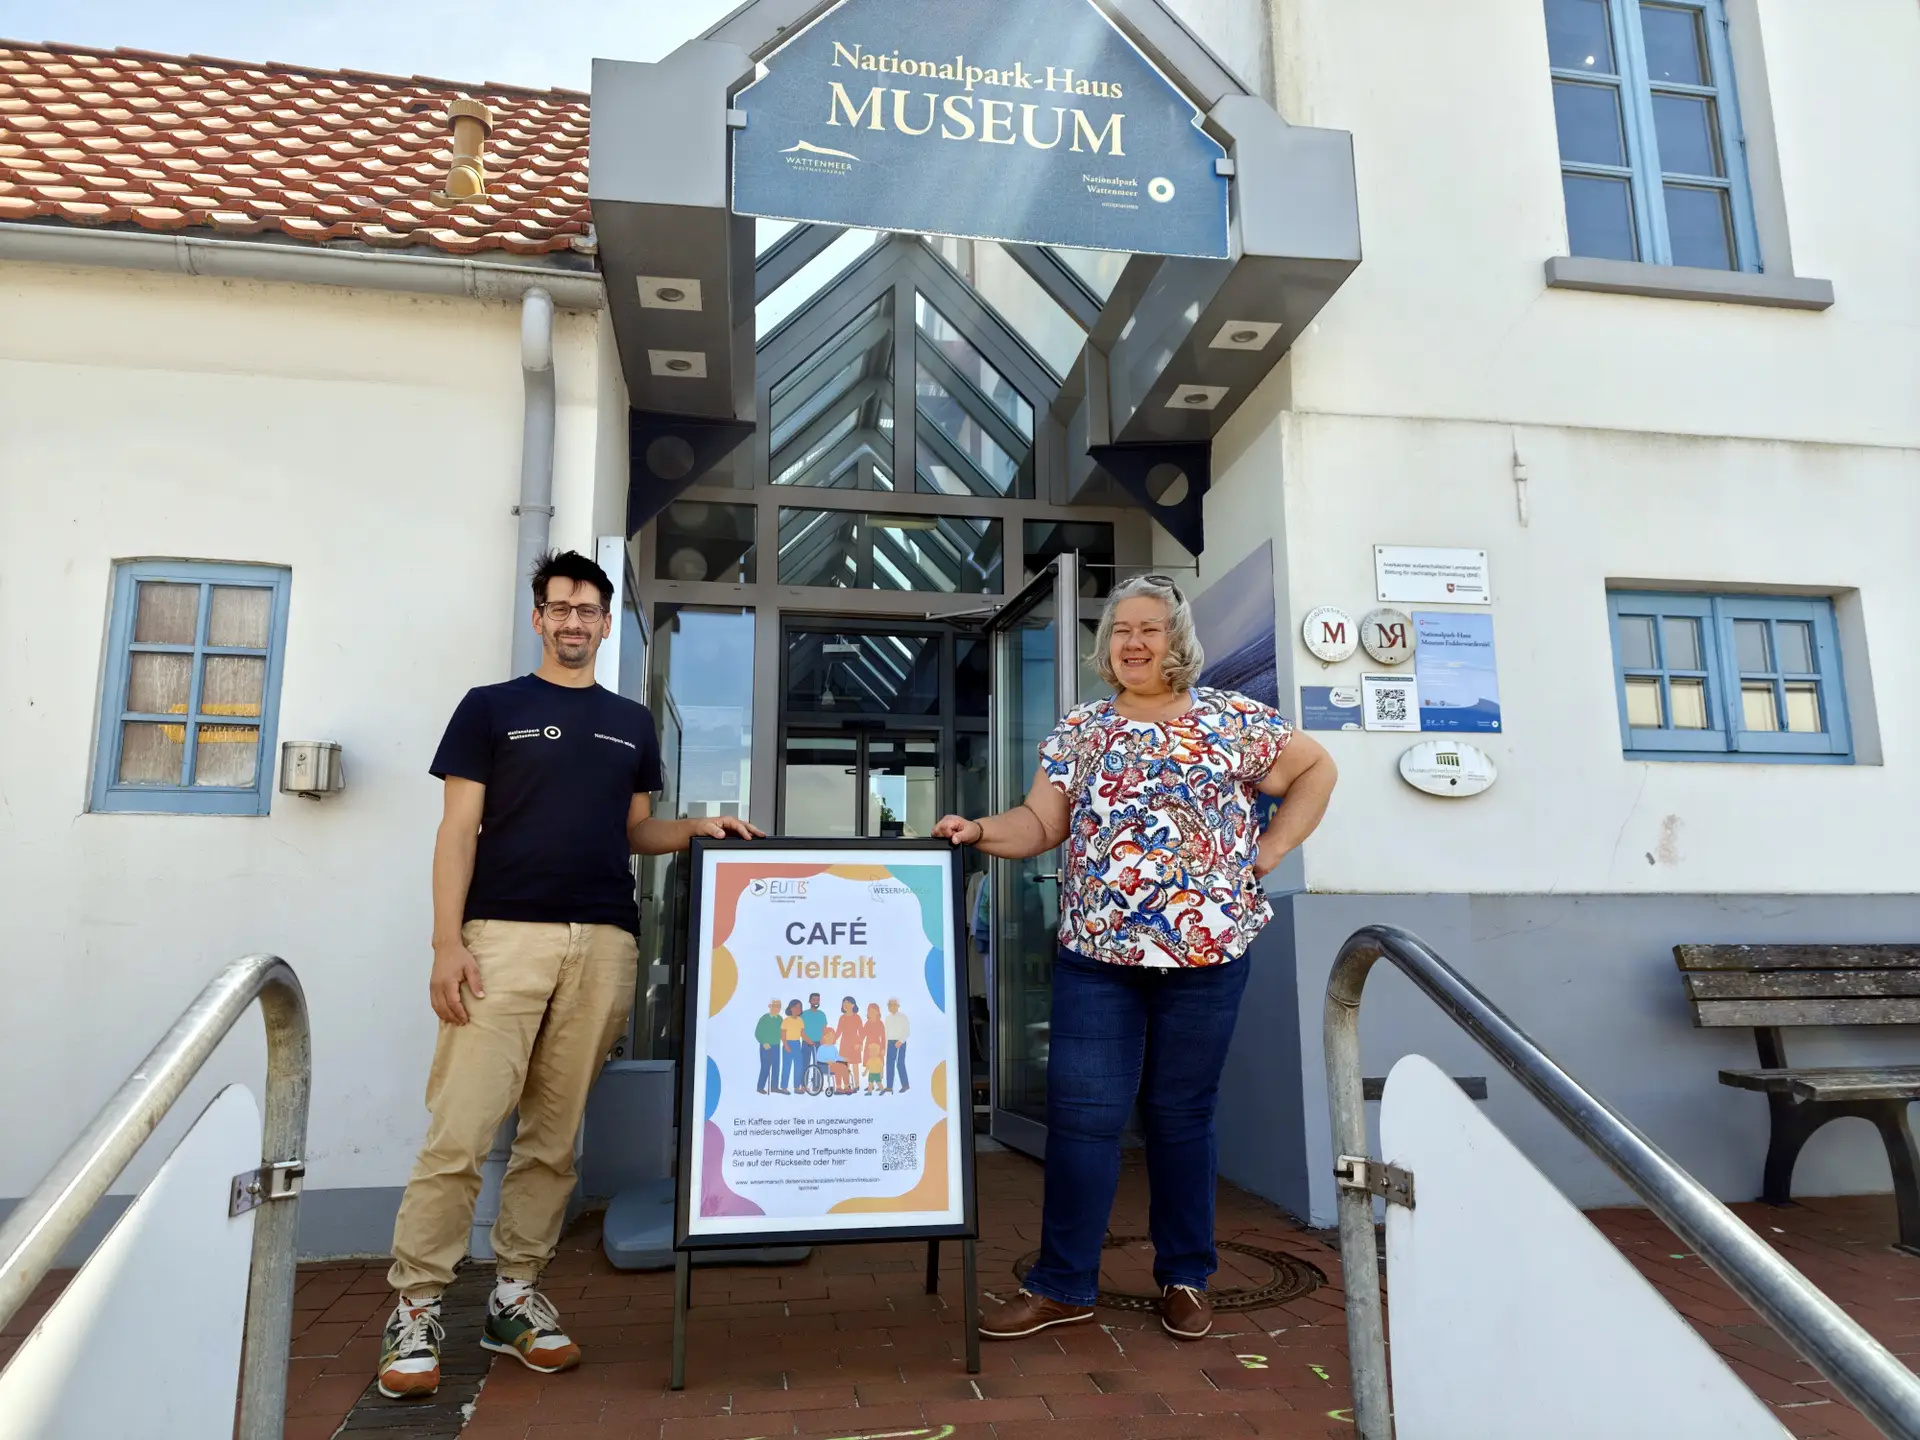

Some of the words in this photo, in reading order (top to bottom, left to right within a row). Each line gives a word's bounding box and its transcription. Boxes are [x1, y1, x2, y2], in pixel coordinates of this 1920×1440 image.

[832, 41, 1123, 99] Nationalpark-Haus
[826, 81, 1126, 156] MUSEUM
[786, 156, 852, 171] WATTENMEER
[1082, 174, 1138, 187] Nationalpark
[1087, 184, 1138, 196] Wattenmeer
[1321, 621, 1346, 644] M
[786, 916, 867, 945] CAFÉ
[776, 955, 876, 979] Vielfalt
[816, 1118, 874, 1126] ungezwungener
[749, 1128, 812, 1136] niederschwelliger
[812, 1148, 853, 1156] Treffpunkte
